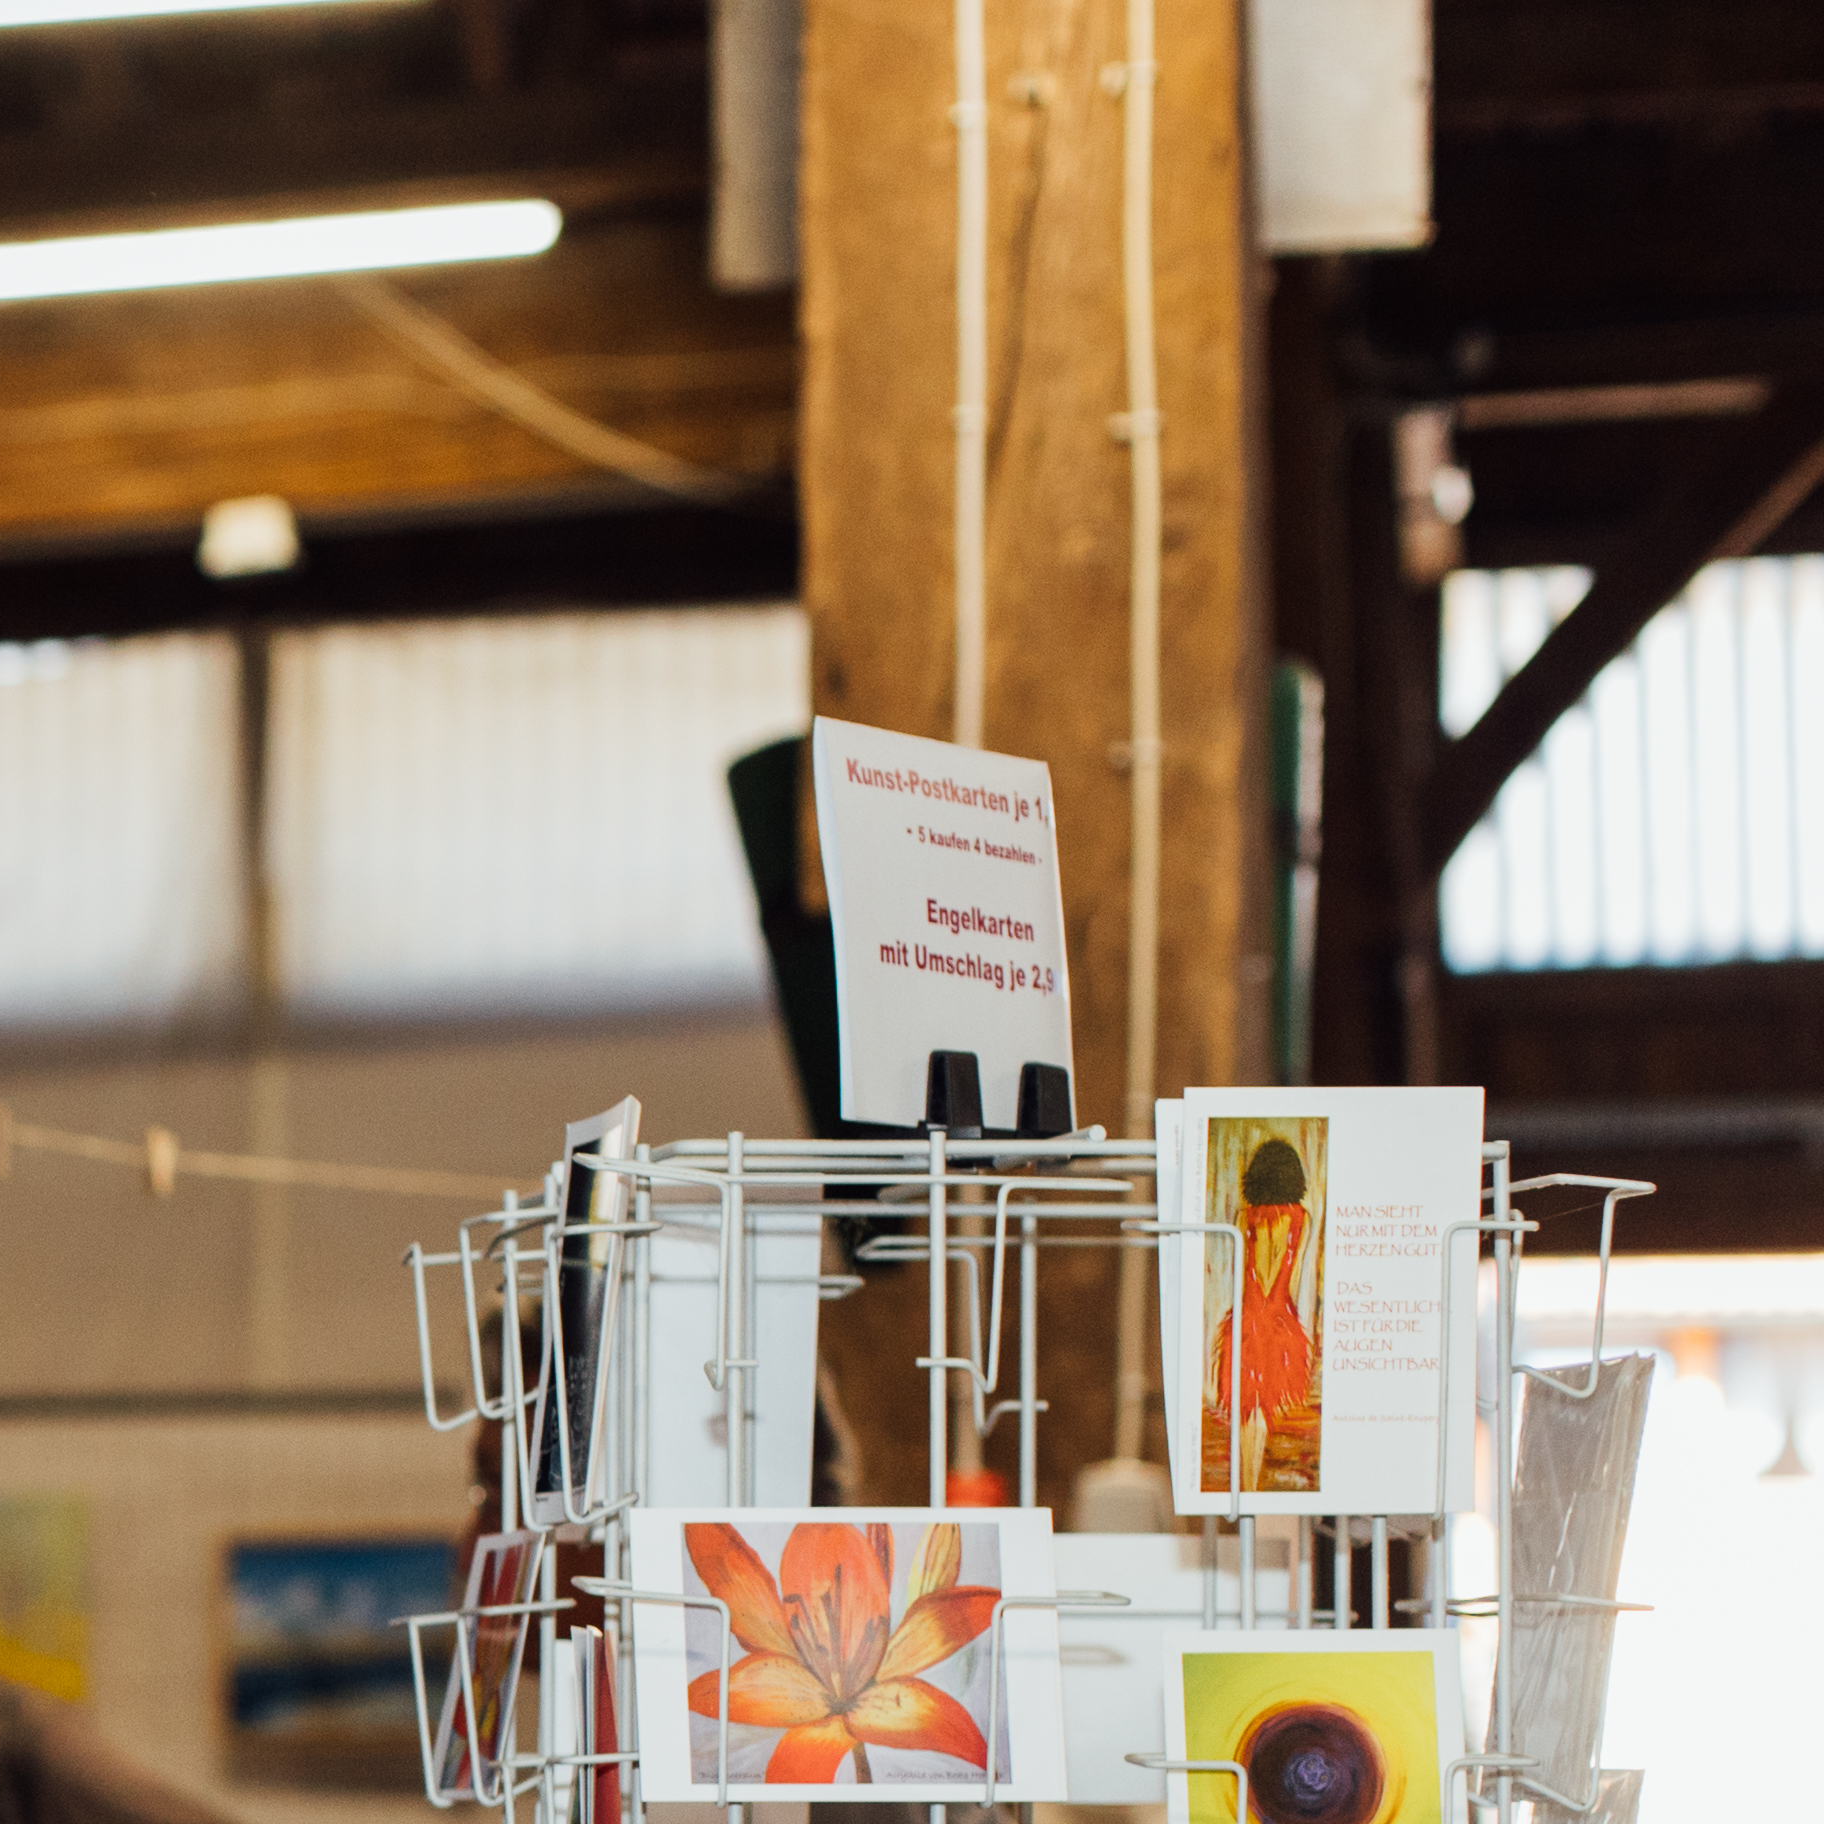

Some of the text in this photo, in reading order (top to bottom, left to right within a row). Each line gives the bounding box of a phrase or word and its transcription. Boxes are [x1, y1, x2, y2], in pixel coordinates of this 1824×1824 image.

[846, 757, 1009, 813] Kunst-Postkarten
[1014, 790, 1029, 822] je
[917, 826, 926, 842] 5
[930, 829, 971, 852] kaufen
[973, 838, 981, 853] 4
[984, 839, 1036, 865] bezahlen
[926, 898, 1034, 941] Engelkarten
[880, 940, 909, 967] mit
[915, 943, 1003, 989] Umschlag
[1009, 960, 1025, 992] je
[1336, 1205, 1424, 1218] MAN SIEHT
[1336, 1224, 1437, 1237] NUR MIT DEM
[1335, 1243, 1401, 1256] HERZEN
[1337, 1281, 1373, 1294] DAS
[1333, 1316, 1424, 1333] IST FÜR DIE
[1333, 1339, 1392, 1351] AUGEN
